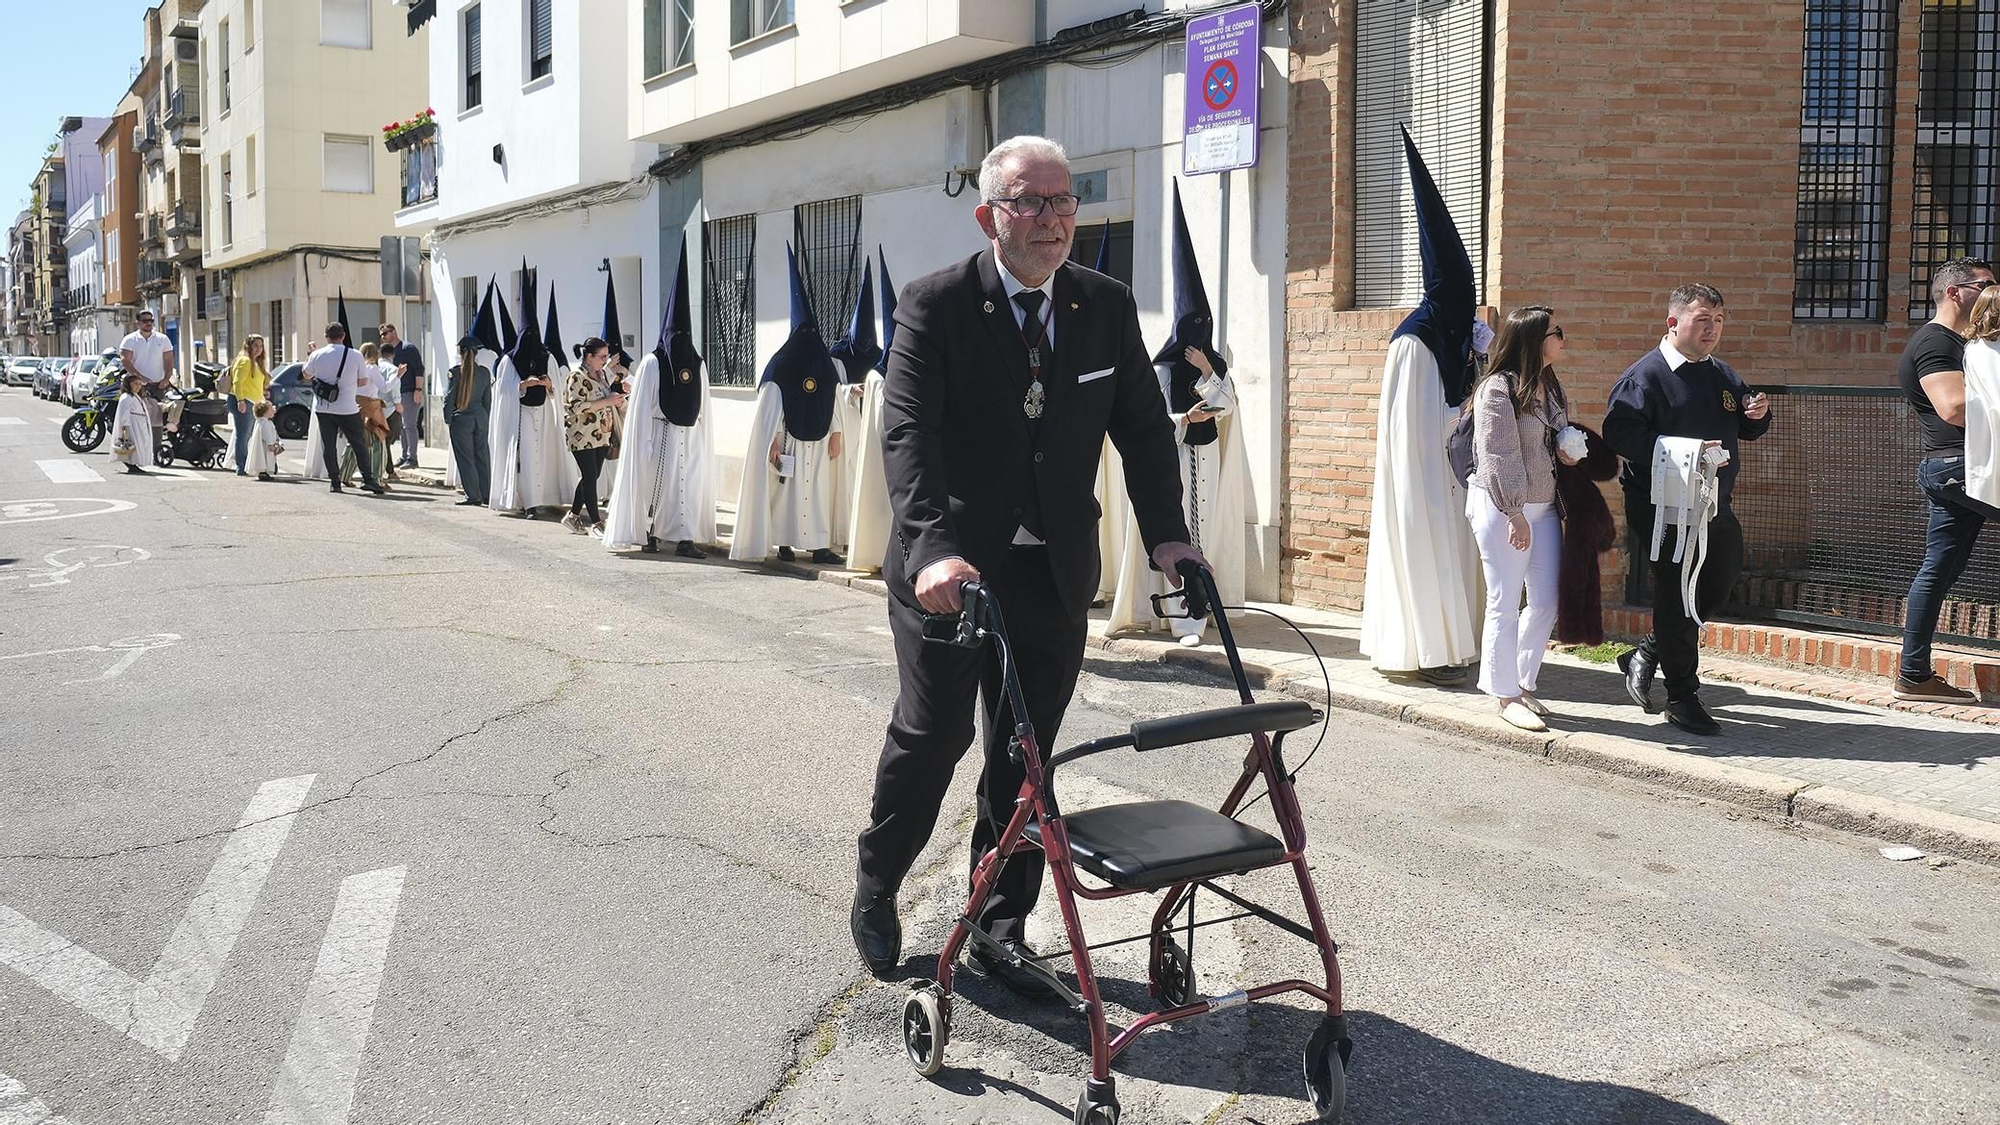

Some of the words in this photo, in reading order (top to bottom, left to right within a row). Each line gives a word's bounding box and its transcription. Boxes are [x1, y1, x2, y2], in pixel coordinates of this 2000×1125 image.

[1190, 27, 1224, 41] AYUNTAMIENTO
[1225, 25, 1231, 33] DE
[1232, 19, 1254, 31] CÓRDOBA
[1203, 44, 1216, 54] PLAN
[1217, 40, 1239, 51] ESPECIAL
[1203, 52, 1223, 63] SEMANA
[1223, 48, 1239, 58] SANTA
[1206, 113, 1214, 122] DE
[1214, 109, 1242, 120] SEGURIDAD
